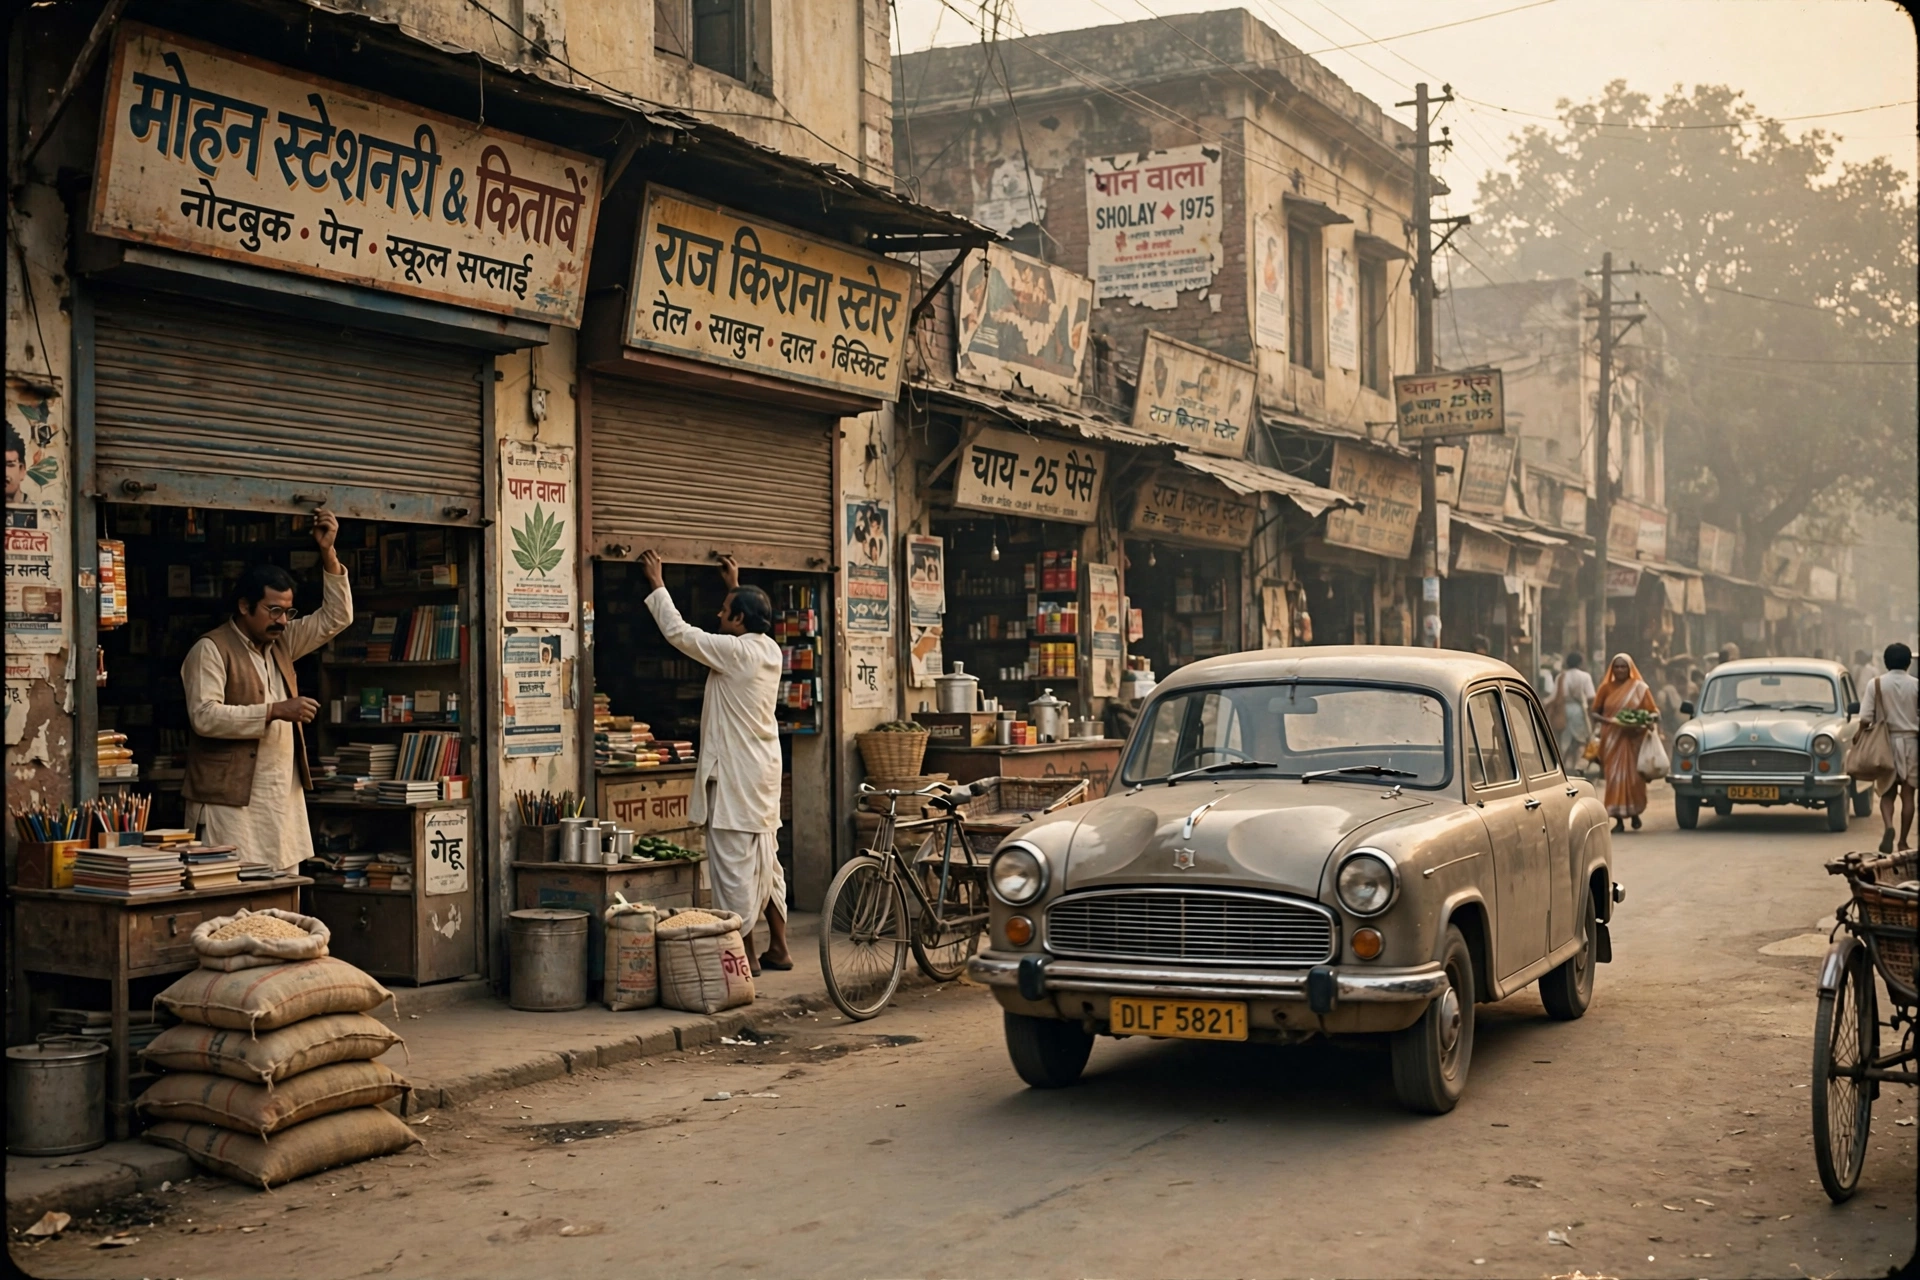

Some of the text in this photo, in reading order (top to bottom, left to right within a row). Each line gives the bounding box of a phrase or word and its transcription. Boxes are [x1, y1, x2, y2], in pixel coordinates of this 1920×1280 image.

[129, 51, 589, 251] मोहन स्टेशनरी & किताबें
[1145, 161, 1206, 192] वाला
[1096, 195, 1215, 230] SHOLAY 1975
[180, 178, 534, 301] नोटबुक पेन स्कूल सप्लाई
[655, 223, 902, 343] राज किराना स्टोर
[652, 289, 889, 380] तेल साबुन दाल बिस्किट
[507, 477, 567, 503] पान वाला
[972, 444, 1019, 491] चाय
[1031, 455, 1060, 497] 25
[1065, 449, 1097, 502] पैसे
[613, 794, 689, 823] पान वाला
[430, 829, 465, 870] गेहू
[1122, 1003, 1234, 1034] DLF 5821
